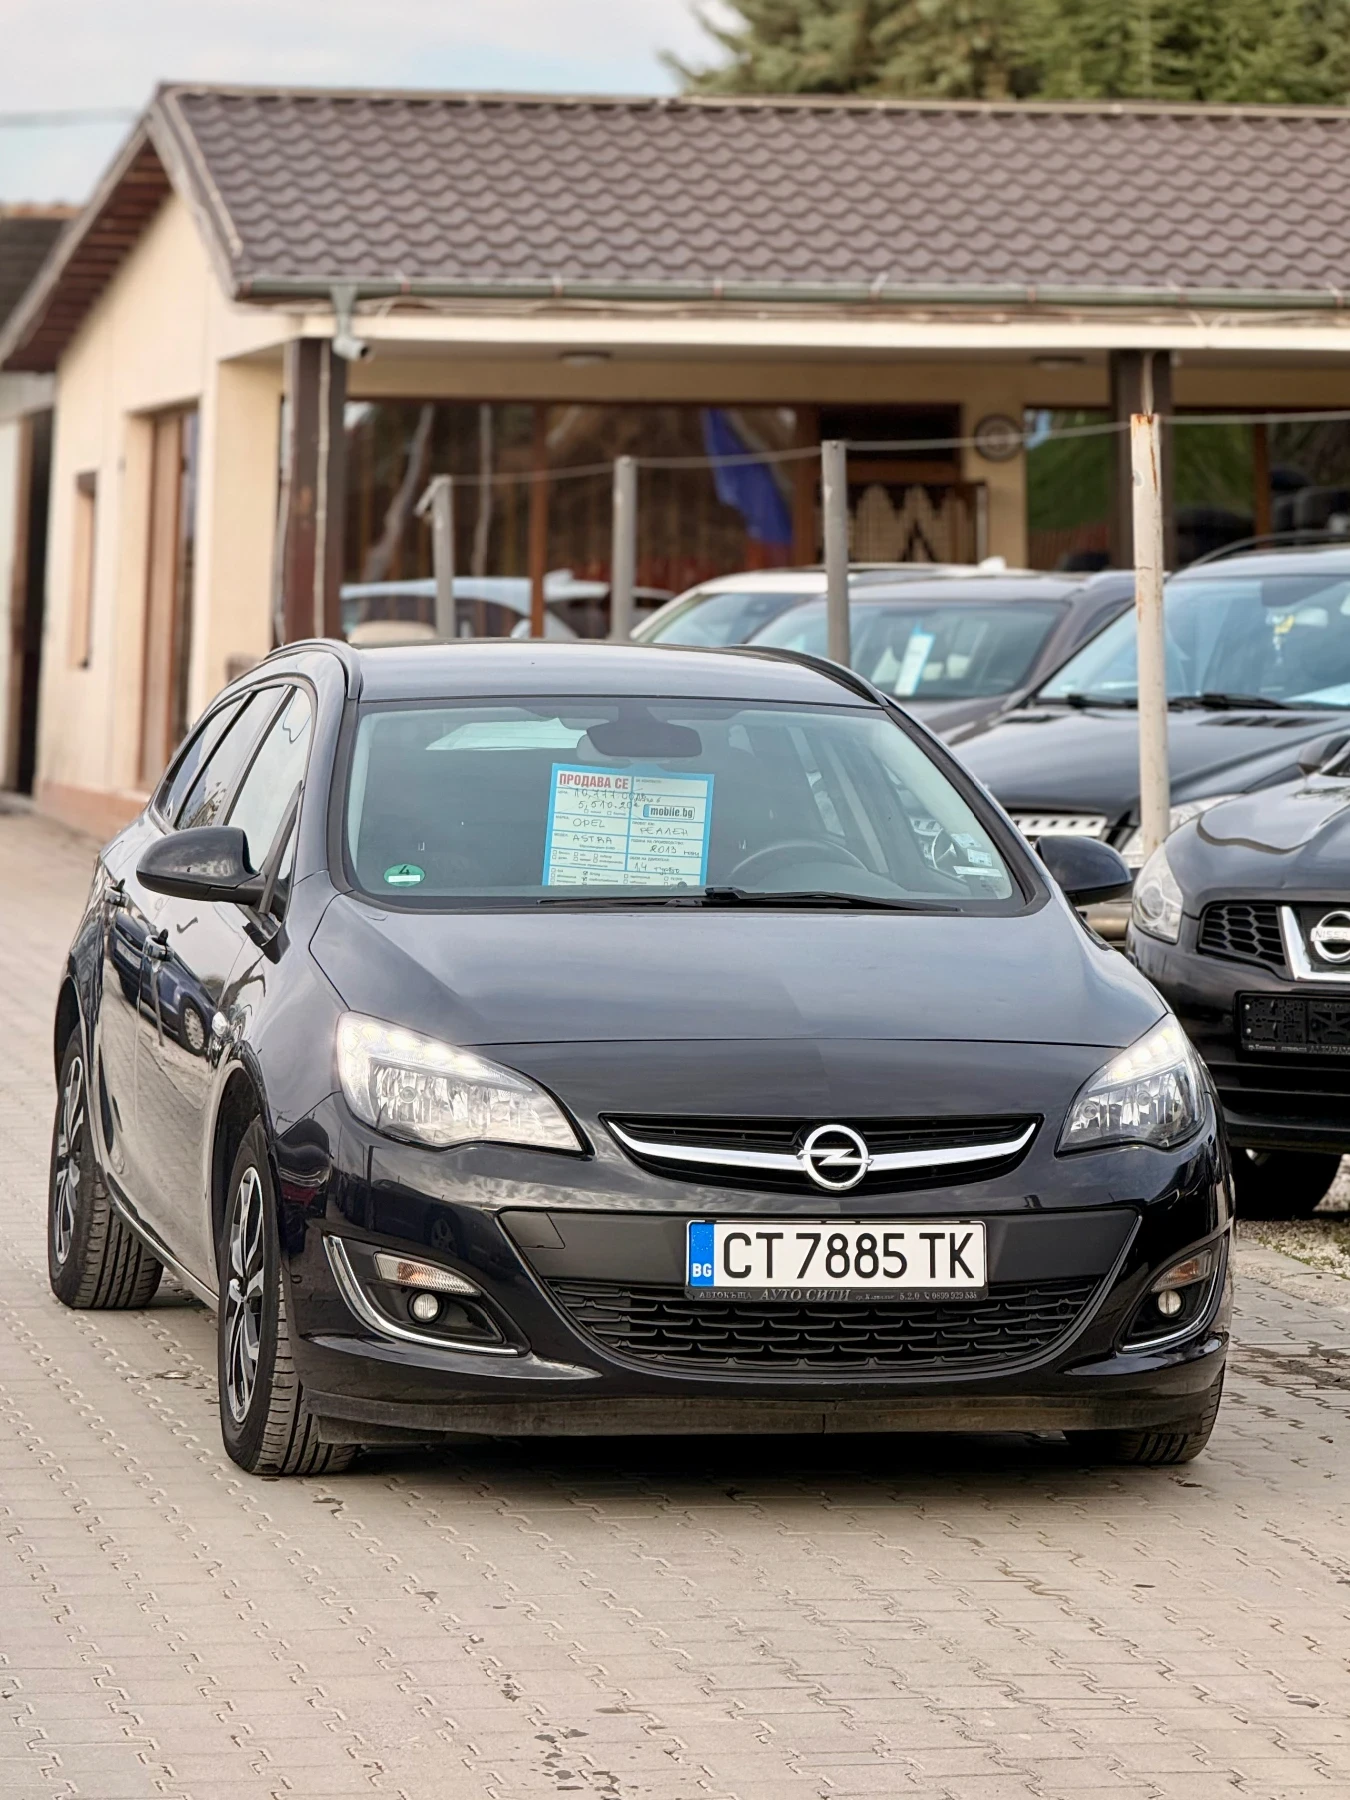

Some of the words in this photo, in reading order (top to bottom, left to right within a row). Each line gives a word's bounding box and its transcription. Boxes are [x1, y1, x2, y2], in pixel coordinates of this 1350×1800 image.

[559, 773, 612, 789] ПРОДАВА
[615, 777, 630, 790] СЕ
[650, 806, 694, 819] mobile.bg
[572, 818, 606, 829] OPEL
[572, 834, 613, 845] ASTRA
[650, 844, 677, 854] 2013
[398, 864, 410, 875] 4
[723, 1232, 784, 1279] CT
[795, 1232, 908, 1279] 7885
[918, 1232, 975, 1279] TK
[691, 1263, 713, 1278] BG
[759, 1288, 801, 1301] АУТО
[806, 1288, 852, 1301] СИТИ
